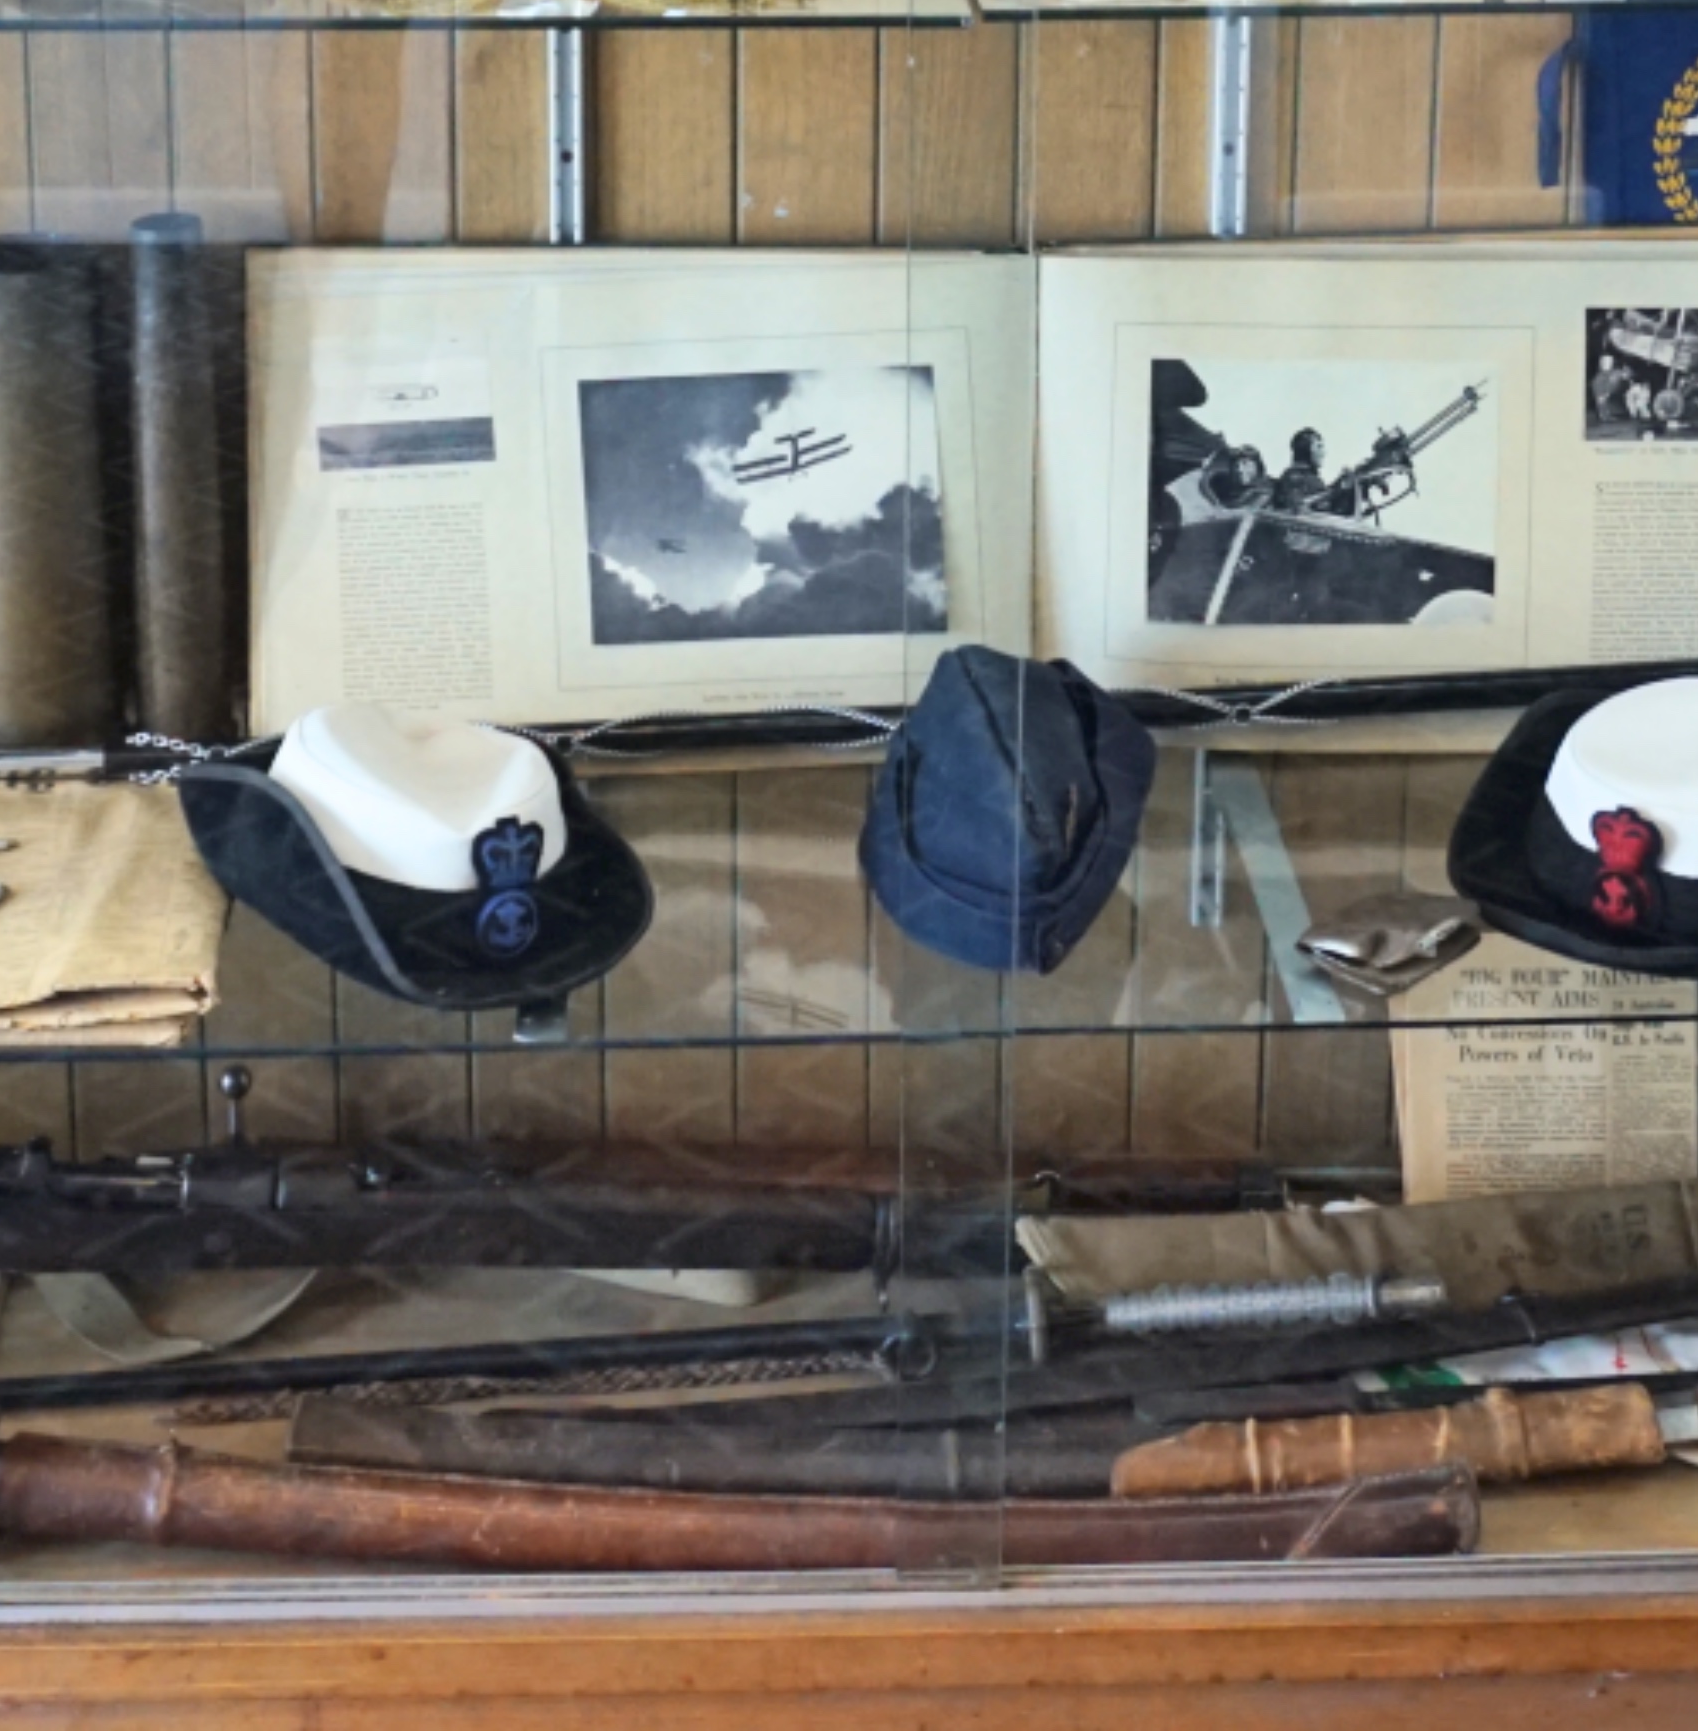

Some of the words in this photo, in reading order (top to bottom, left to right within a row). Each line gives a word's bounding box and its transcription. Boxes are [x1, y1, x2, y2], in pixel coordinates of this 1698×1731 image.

[1551, 990, 1601, 1009] AIMS
[1459, 1044, 1519, 1063] Powers
[1527, 1044, 1546, 1062] of
[1554, 1044, 1594, 1063] Veto
